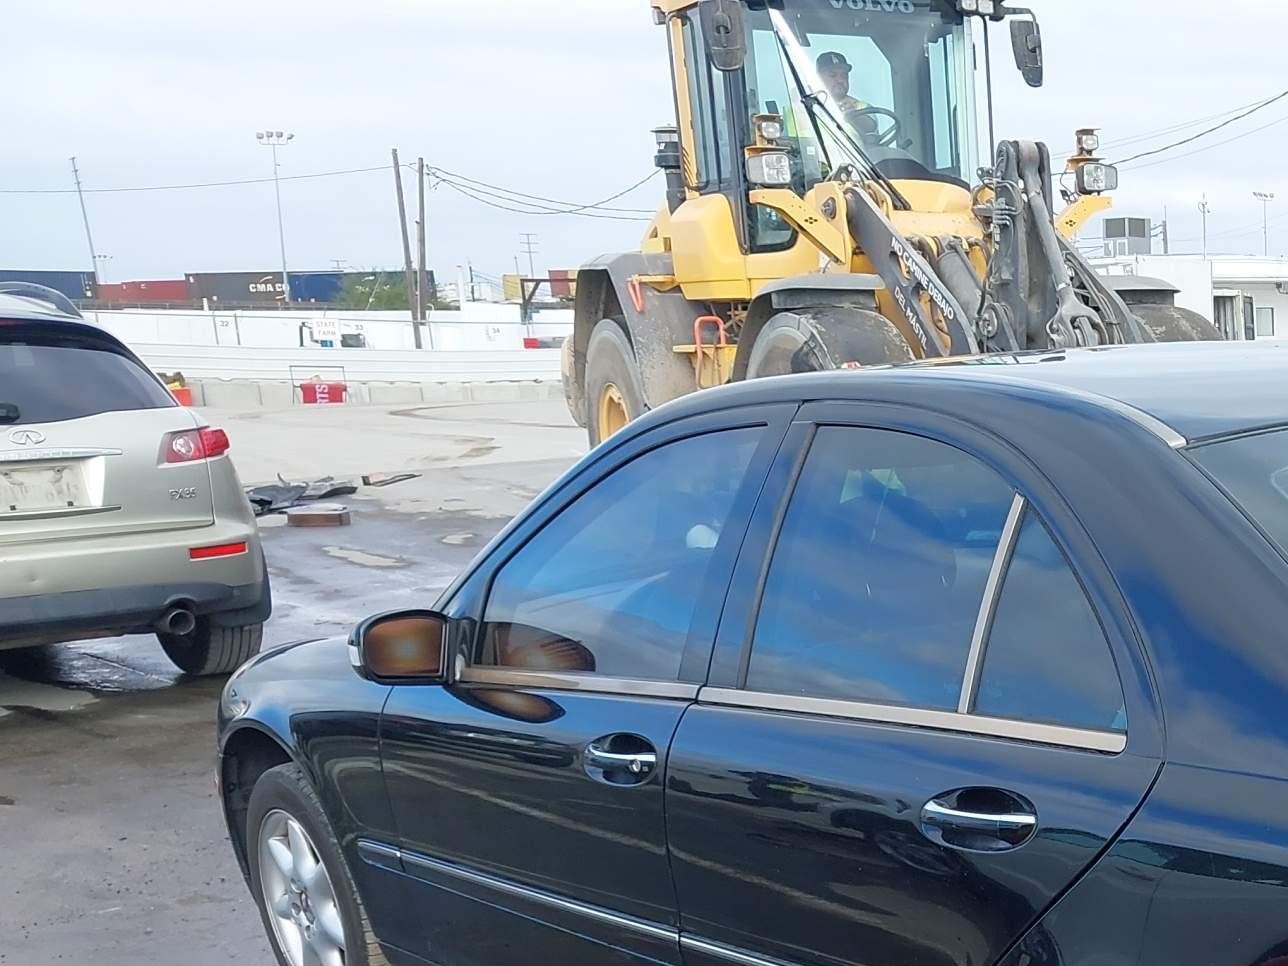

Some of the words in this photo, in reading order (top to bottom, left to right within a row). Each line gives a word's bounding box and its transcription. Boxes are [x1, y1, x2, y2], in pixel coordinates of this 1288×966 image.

[249, 283, 274, 292] CMA
[891, 236, 903, 255] NO
[903, 252, 928, 288] CAMINE
[928, 285, 954, 320] DEBAJO
[895, 285, 906, 312] DEL
